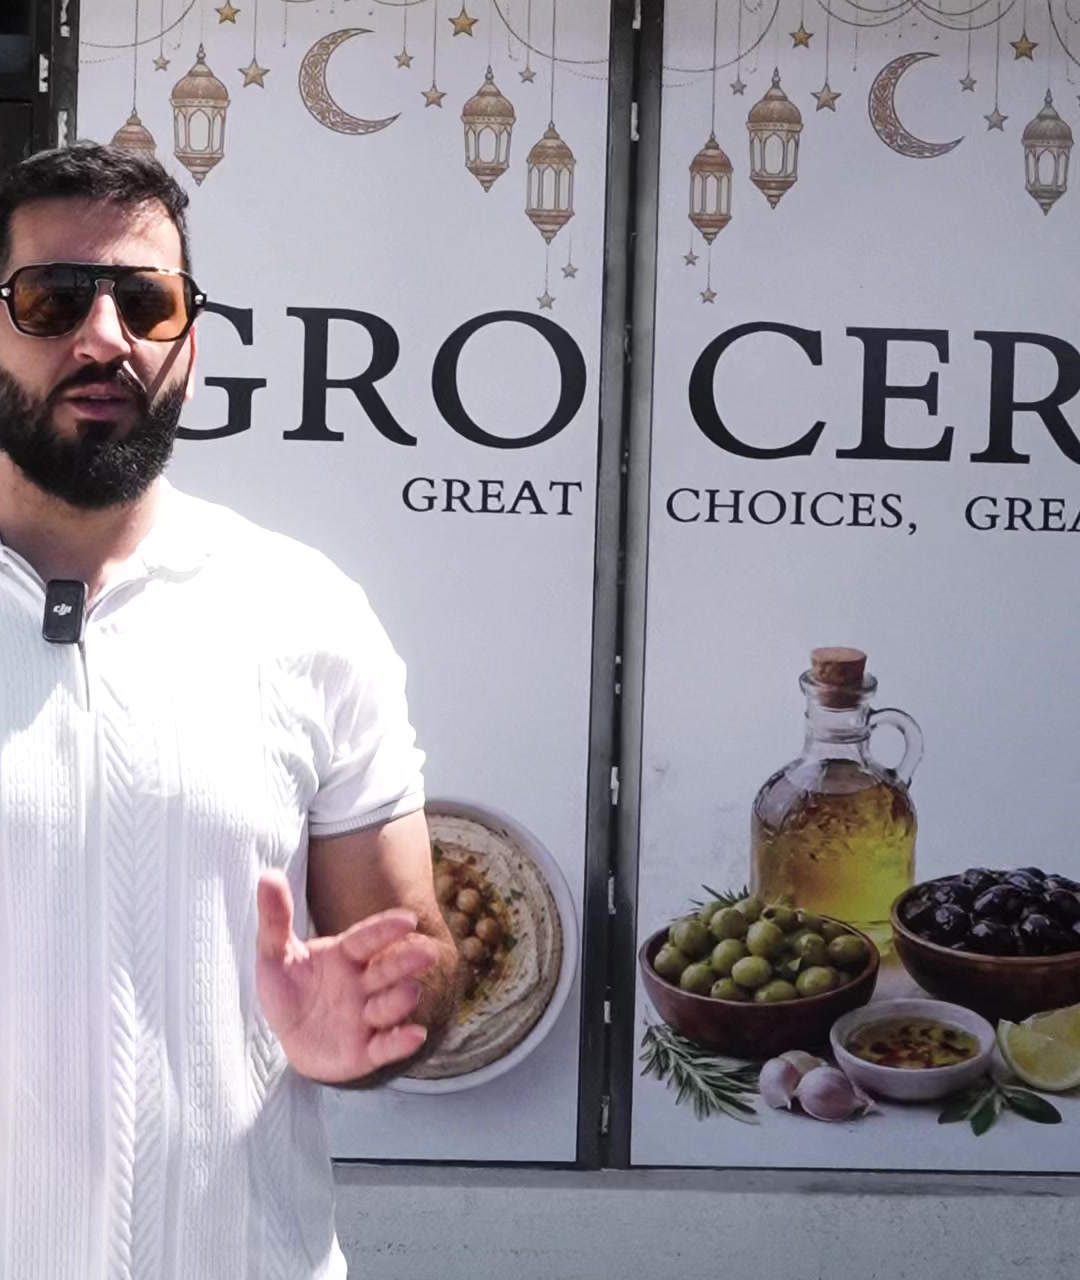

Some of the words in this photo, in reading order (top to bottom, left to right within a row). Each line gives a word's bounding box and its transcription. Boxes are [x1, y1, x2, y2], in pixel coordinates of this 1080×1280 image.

[688, 320, 1080, 465] CER
[402, 476, 583, 517] GREAT
[666, 486, 919, 535] CHOICES,
